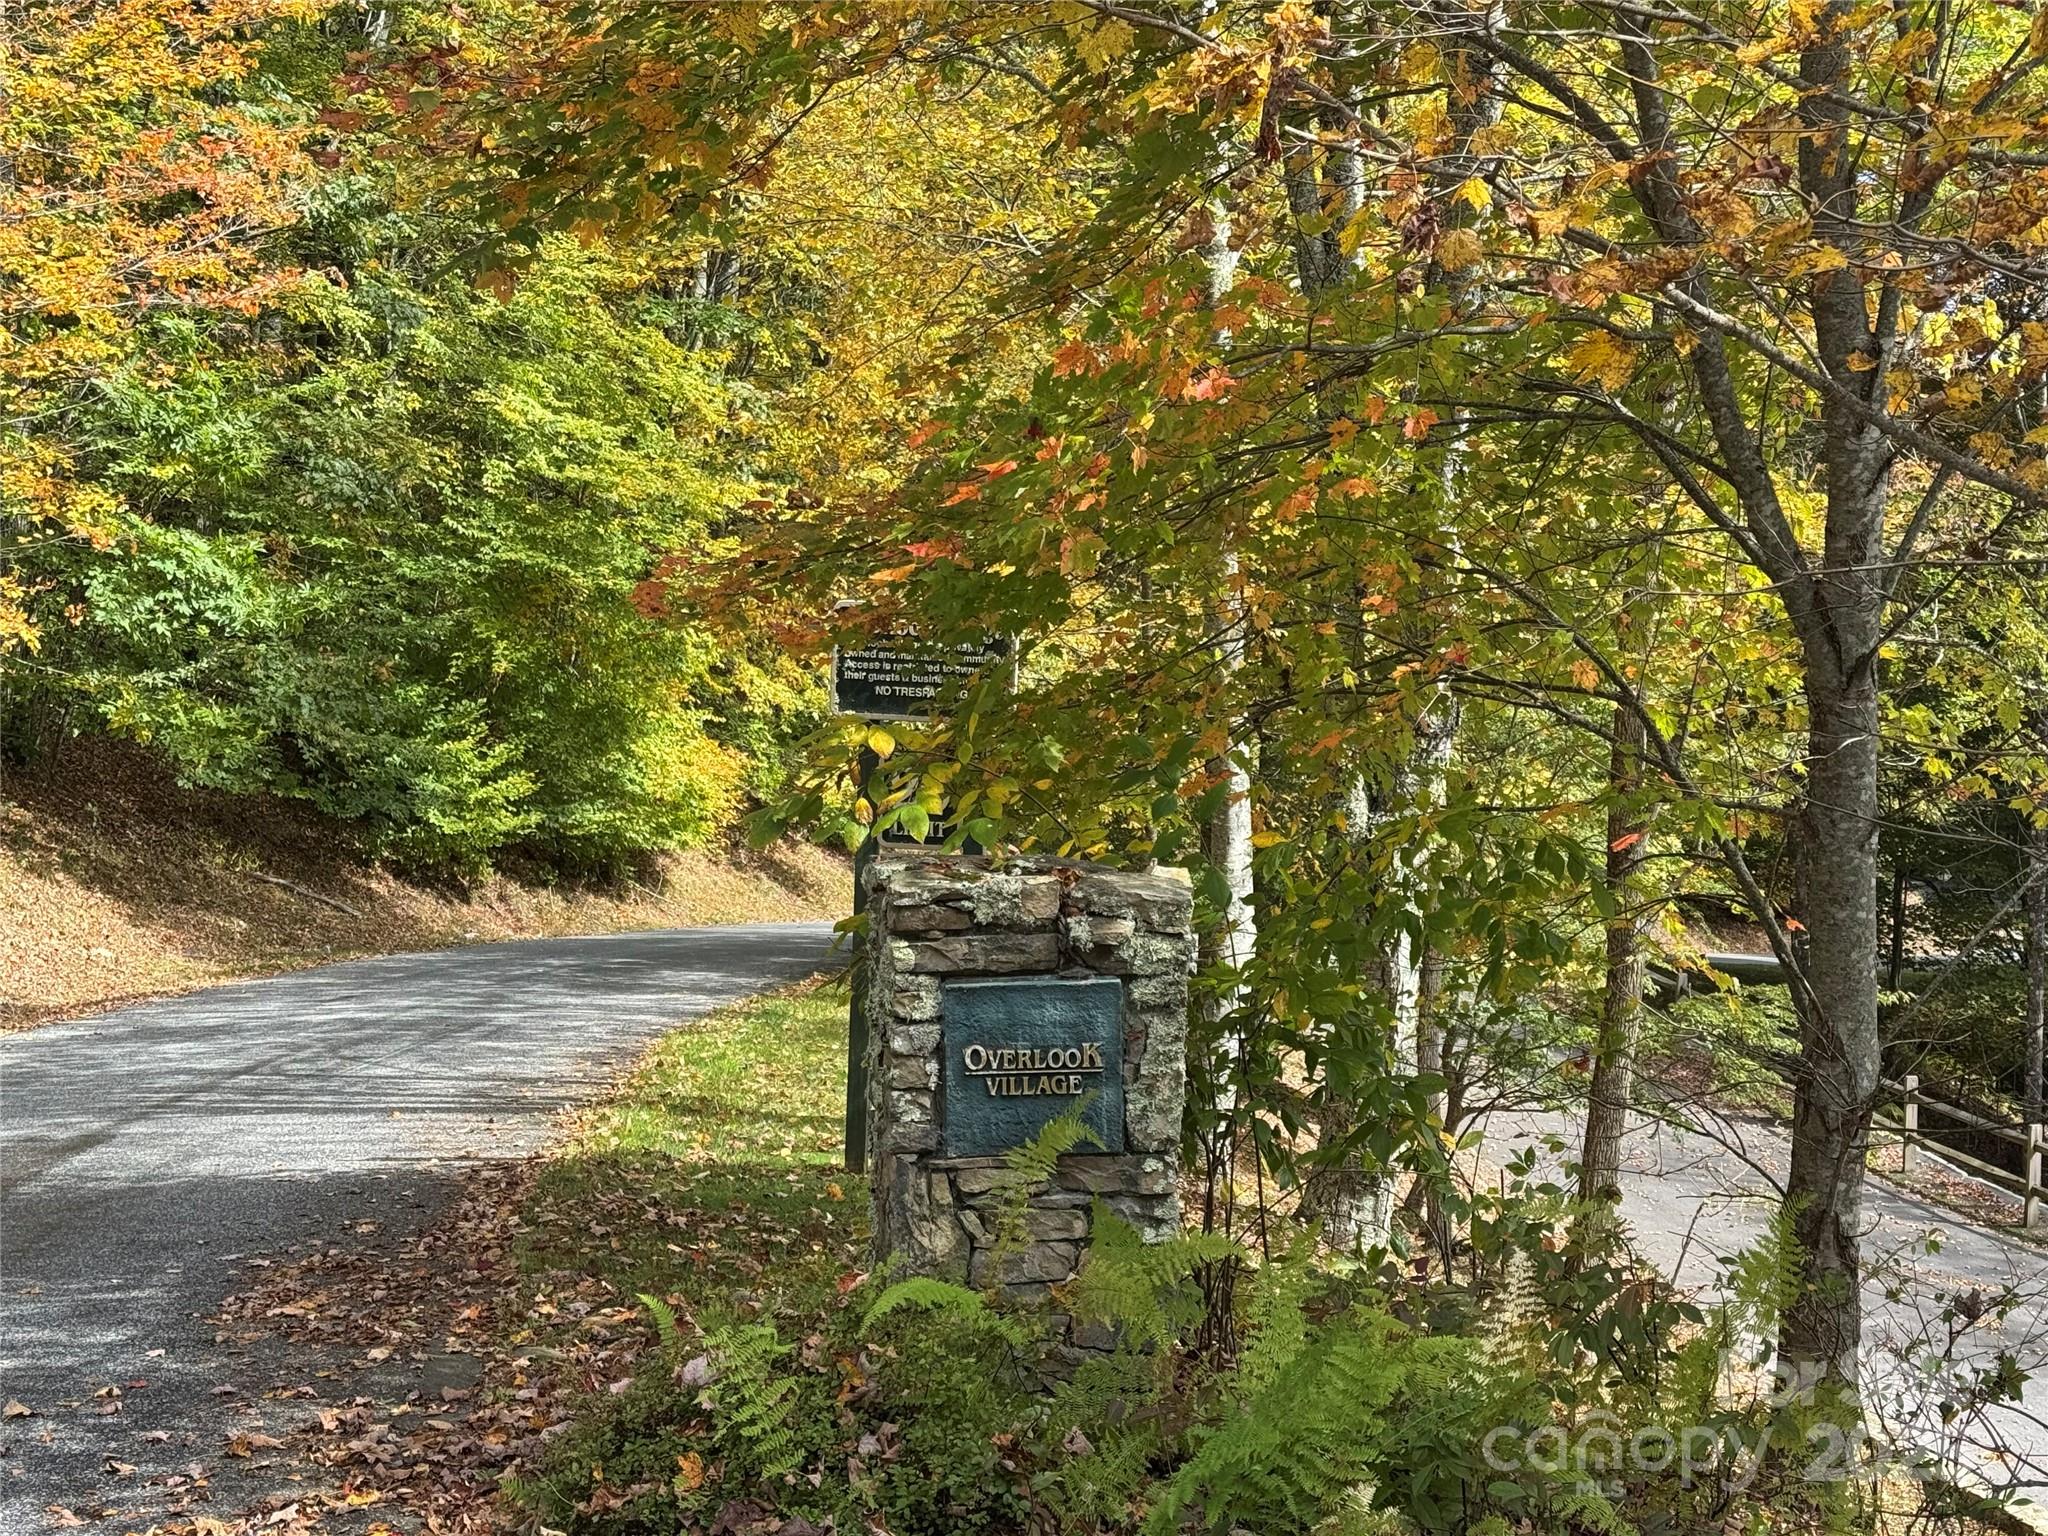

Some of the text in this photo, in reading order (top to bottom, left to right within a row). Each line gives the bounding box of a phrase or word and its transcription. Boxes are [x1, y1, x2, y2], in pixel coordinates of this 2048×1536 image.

[878, 650, 896, 659] and
[843, 659, 880, 669] Access
[943, 663, 954, 673] to
[844, 670, 867, 680] their
[868, 672, 900, 682] guests
[875, 685, 892, 696] NO
[892, 821, 945, 838] LIIT
[986, 1075, 1083, 1096] VILLAGE
